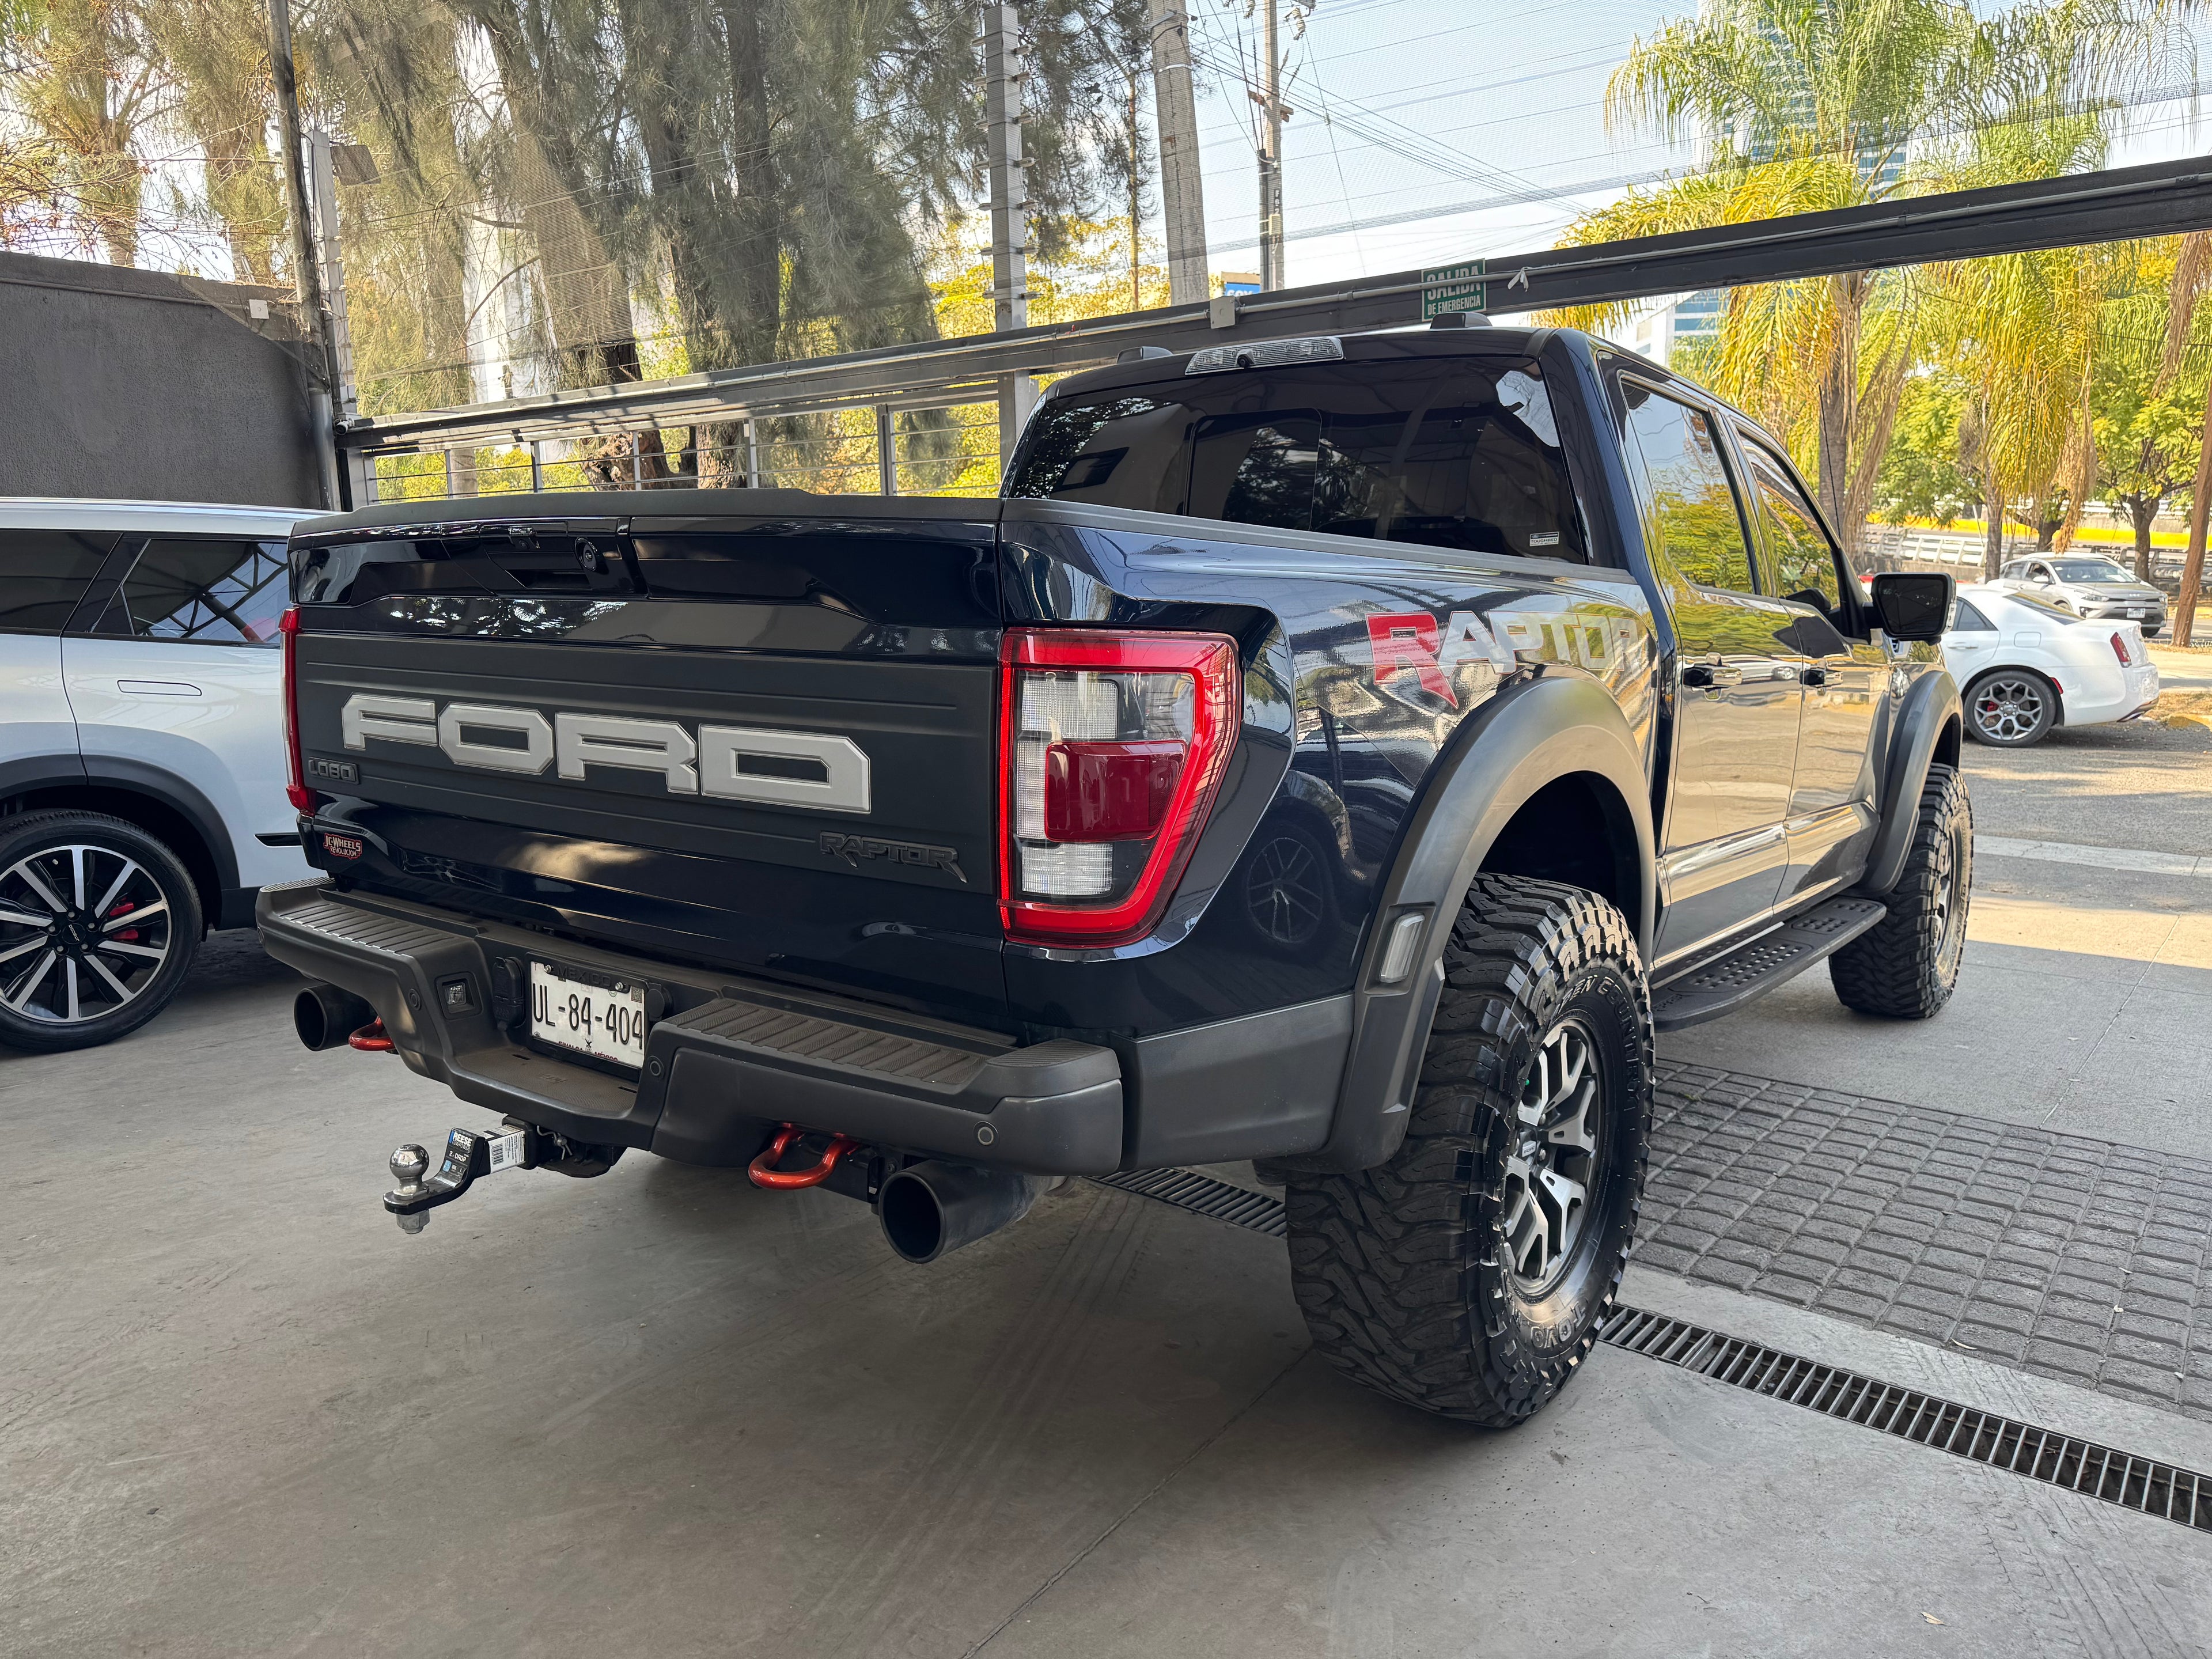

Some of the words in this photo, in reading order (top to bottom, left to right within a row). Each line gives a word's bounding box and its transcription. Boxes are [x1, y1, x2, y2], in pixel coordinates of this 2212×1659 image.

[1426, 265, 1481, 301] SALIDA
[1427, 303, 1437, 316] DE
[1438, 294, 1481, 313] EMERGENCIA
[1366, 611, 1647, 710] RAPTOR
[308, 759, 357, 782] LOBO
[342, 692, 872, 815] FORD
[820, 830, 968, 883] RAPTOR
[532, 983, 643, 1050] UL-84-404
[453, 1131, 472, 1147] REESE
[454, 1153, 467, 1162] DROP
